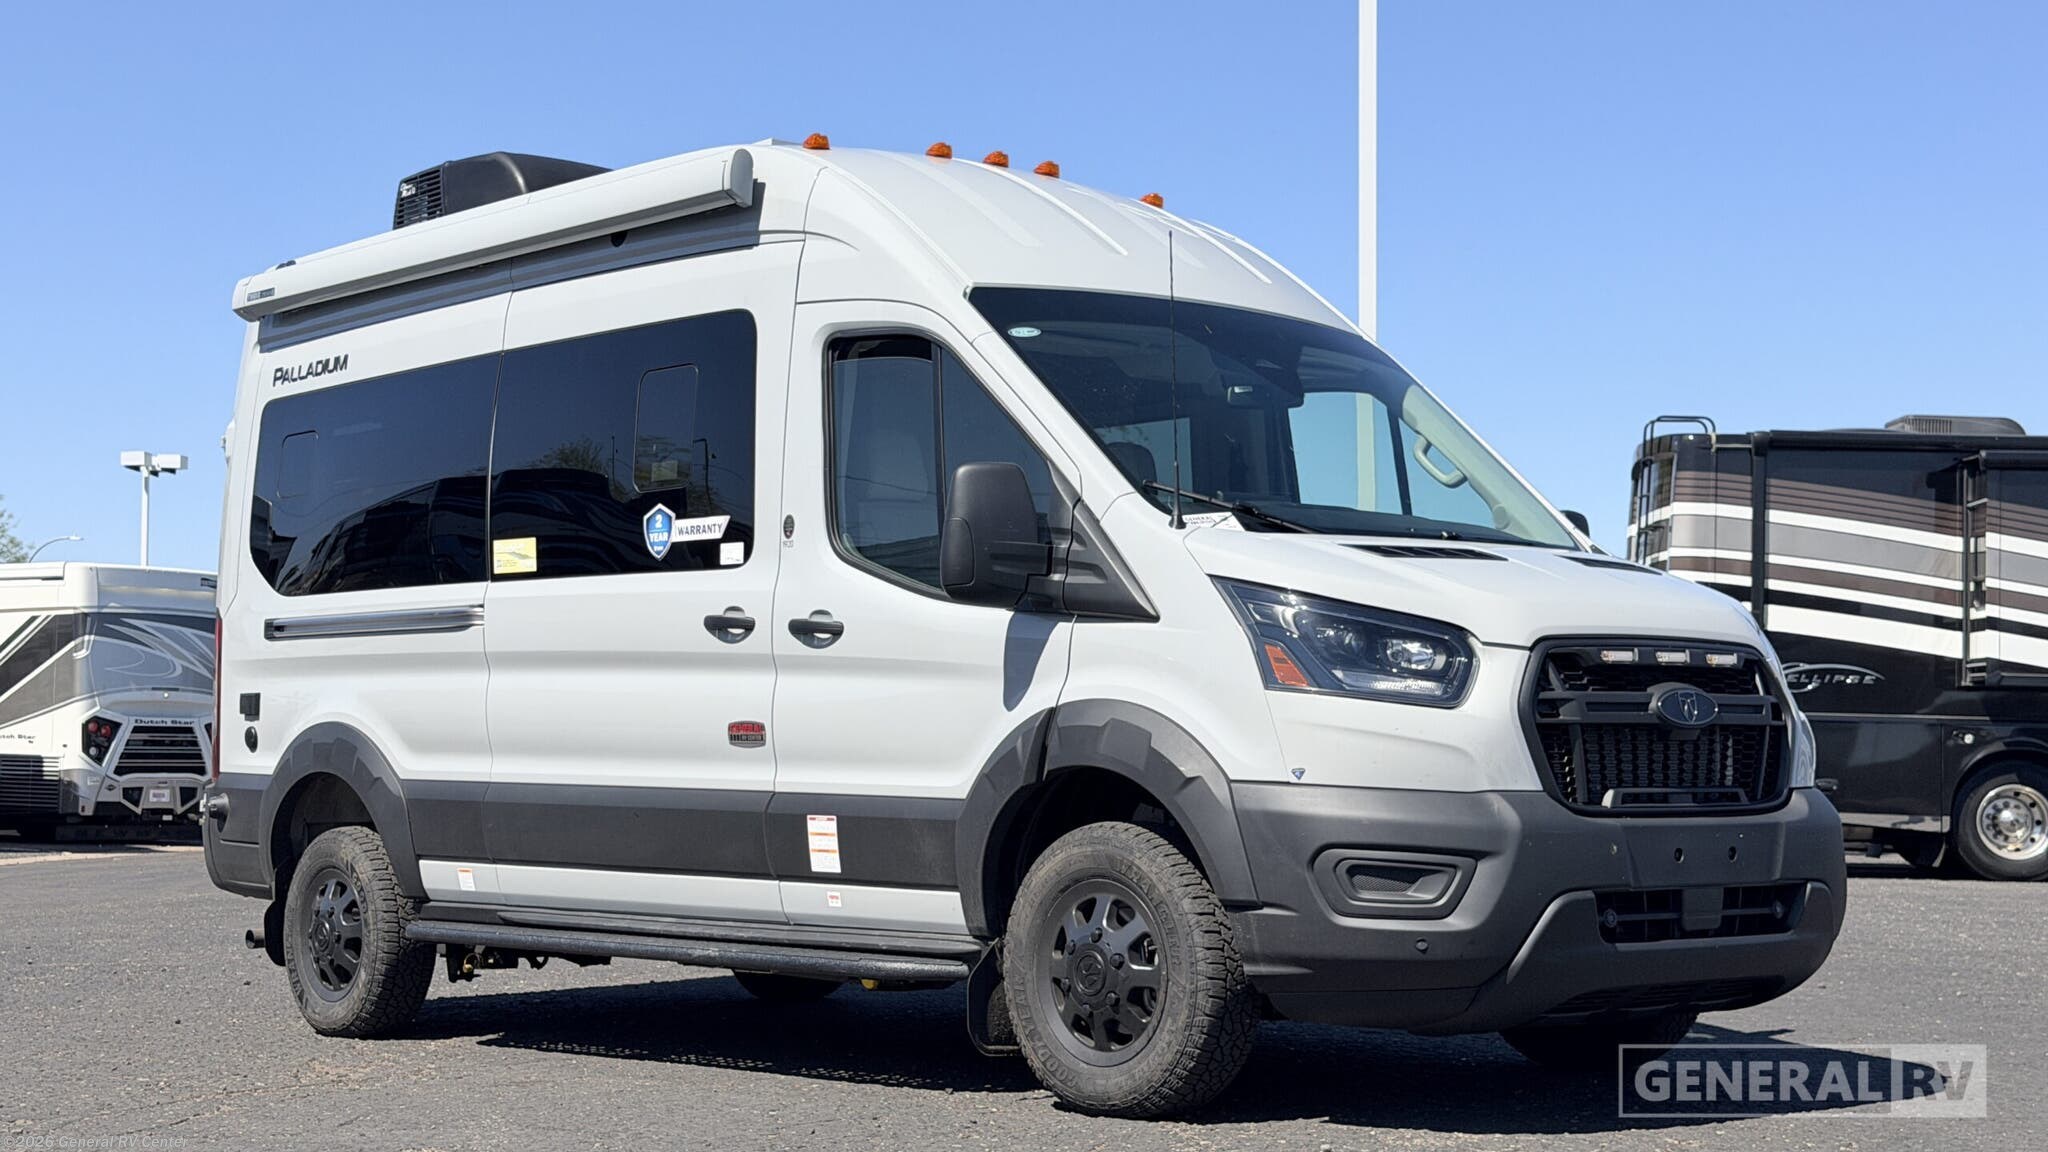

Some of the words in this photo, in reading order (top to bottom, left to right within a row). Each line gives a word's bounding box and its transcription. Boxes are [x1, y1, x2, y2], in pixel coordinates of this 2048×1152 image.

[273, 354, 349, 387] PALLADIUM
[655, 514, 663, 528] 2
[678, 523, 723, 536] WARRANTY
[649, 532, 669, 543] YEAR
